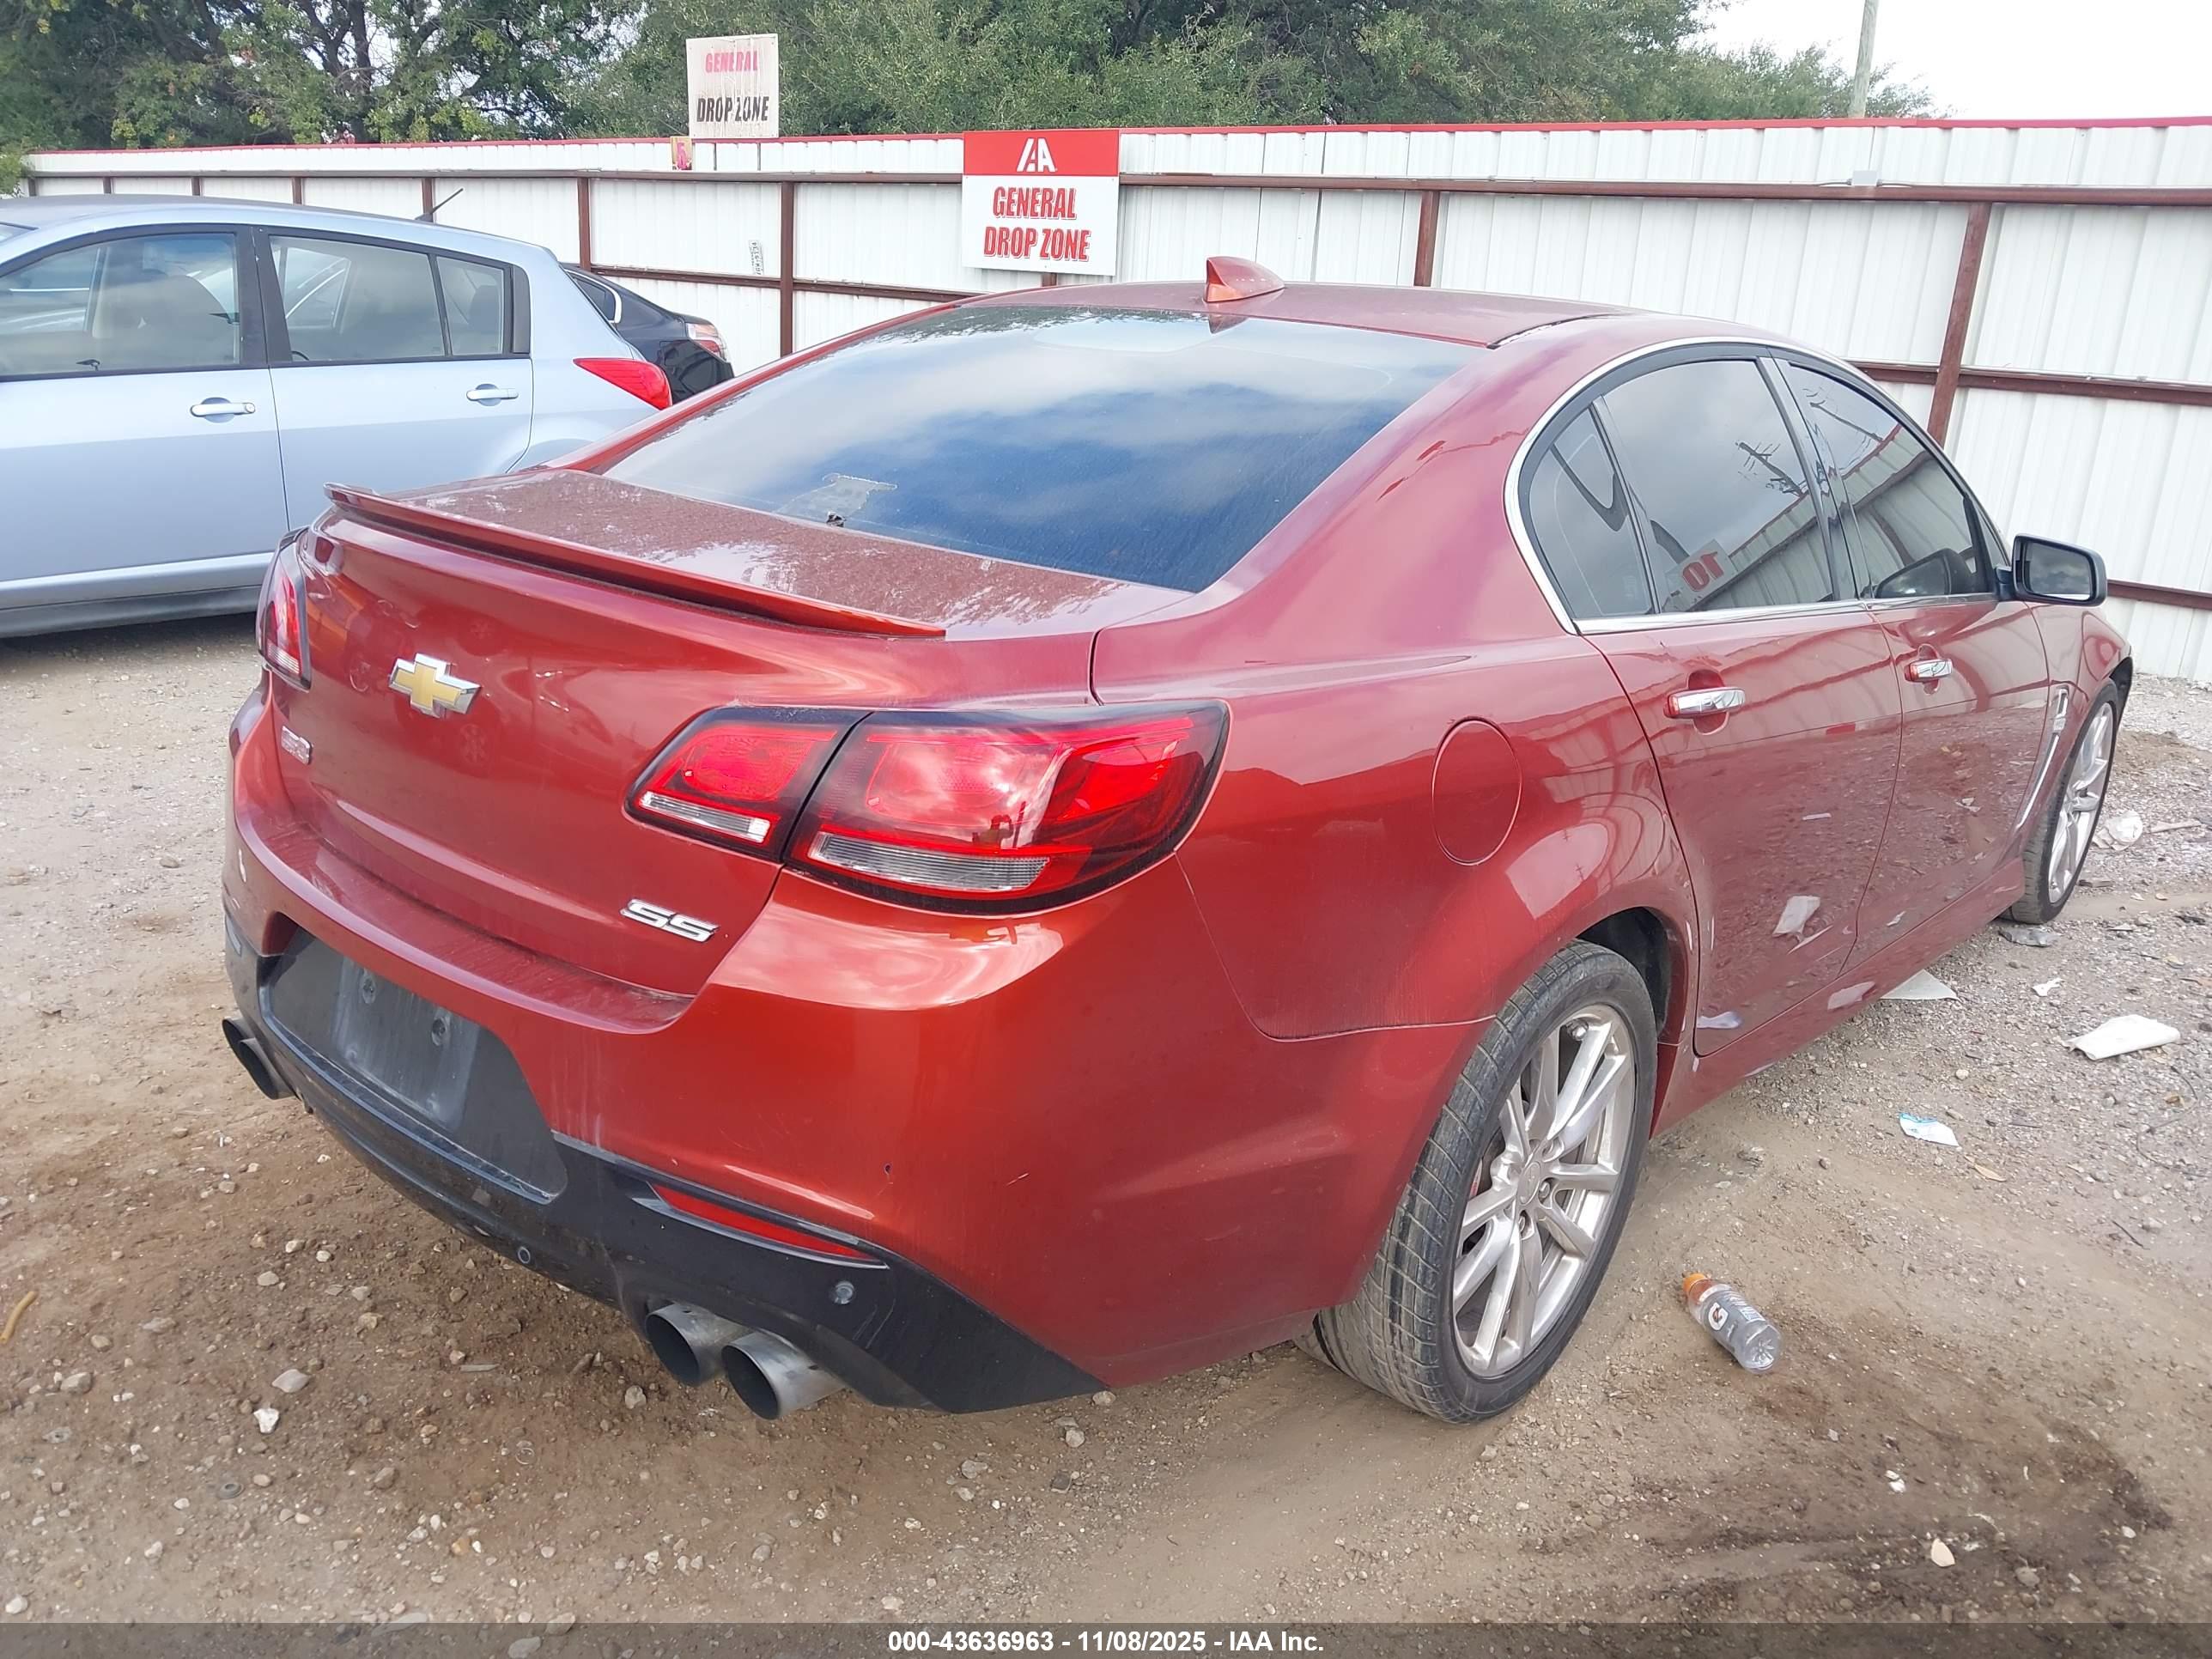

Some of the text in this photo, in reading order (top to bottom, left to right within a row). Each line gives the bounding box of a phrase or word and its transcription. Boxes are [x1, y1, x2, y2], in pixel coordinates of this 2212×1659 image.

[705, 51, 758, 73] GENERAL
[696, 95, 769, 122] DROP ZONE
[993, 186, 1077, 220] GENERAL
[983, 226, 1091, 262] DROP ZONE
[620, 898, 719, 943] SS
